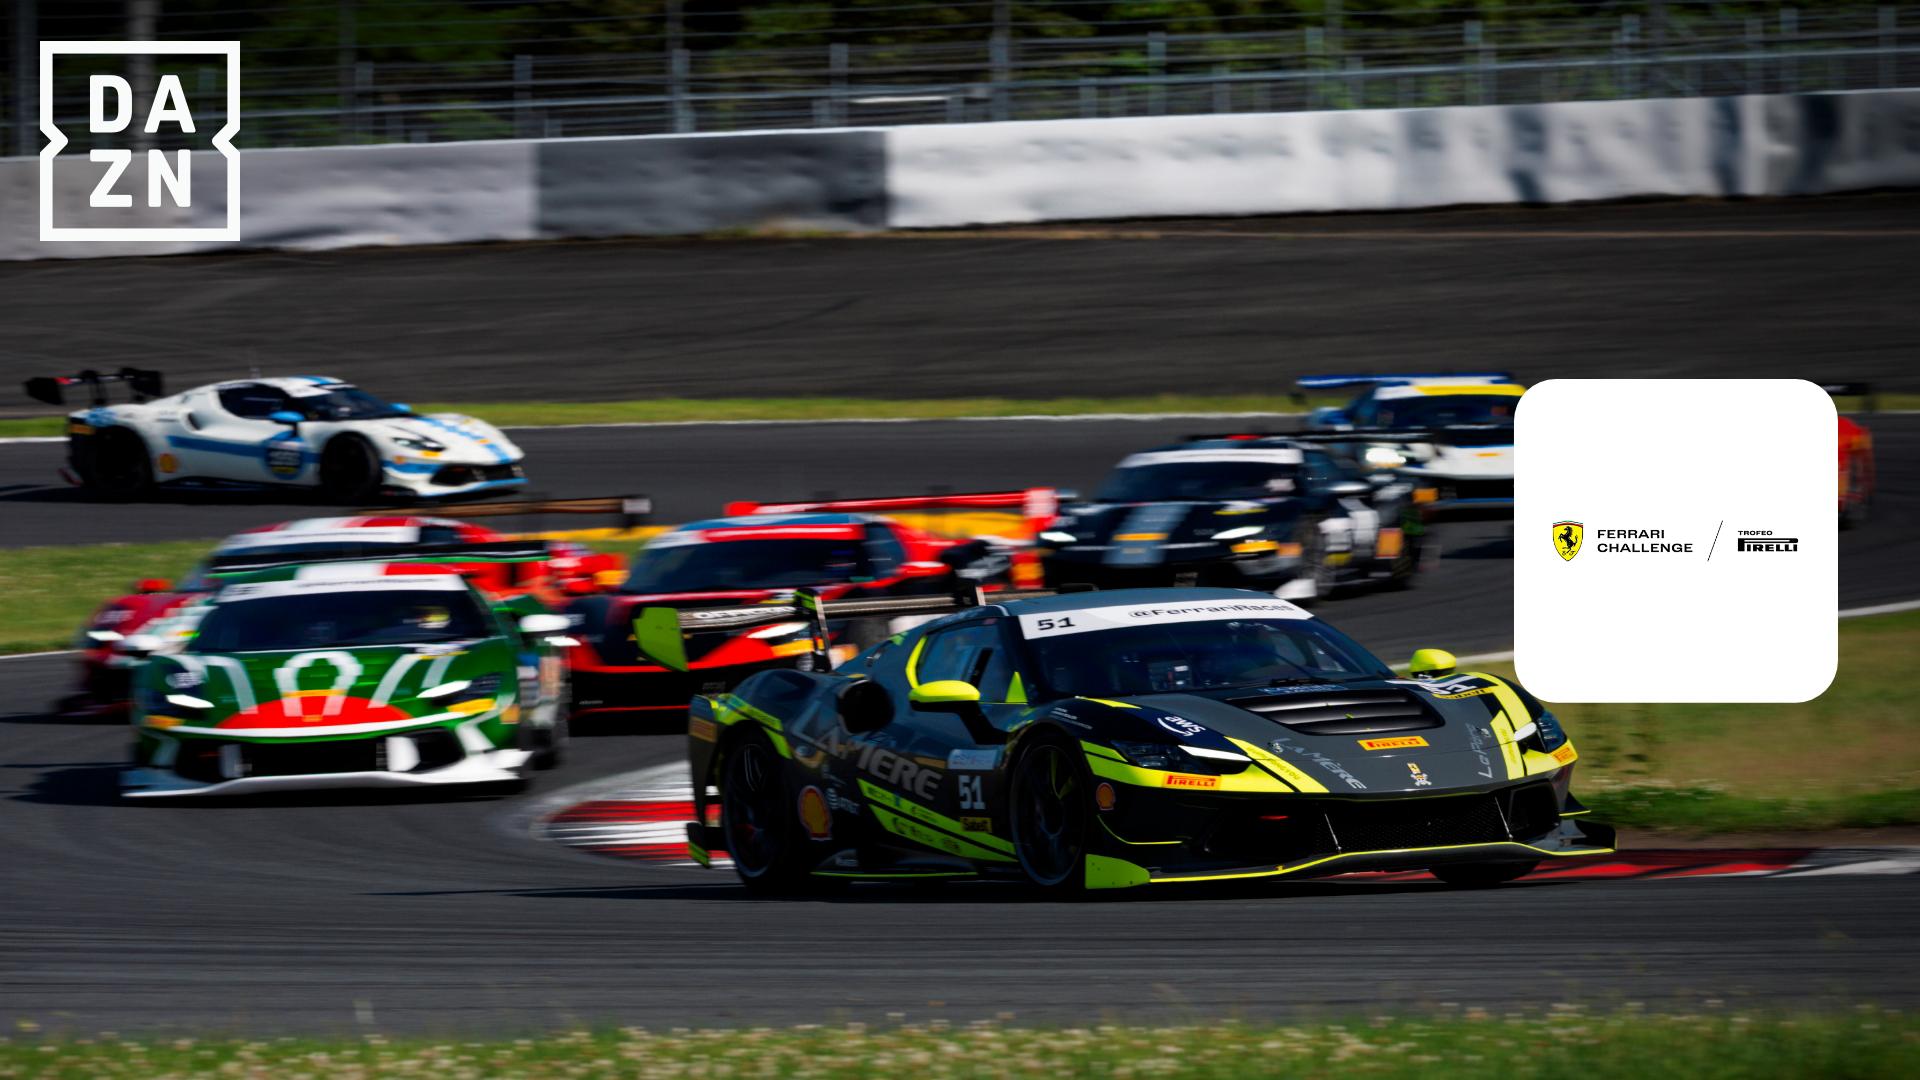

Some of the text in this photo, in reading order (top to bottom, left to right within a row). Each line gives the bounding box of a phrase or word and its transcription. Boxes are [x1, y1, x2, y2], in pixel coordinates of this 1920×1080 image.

[1037, 617, 1075, 630] 51
[1164, 715, 1206, 733] aws
[1366, 737, 1421, 748] PIRELLI
[1166, 774, 1217, 788] PIRELLI
[957, 775, 986, 810] 51
